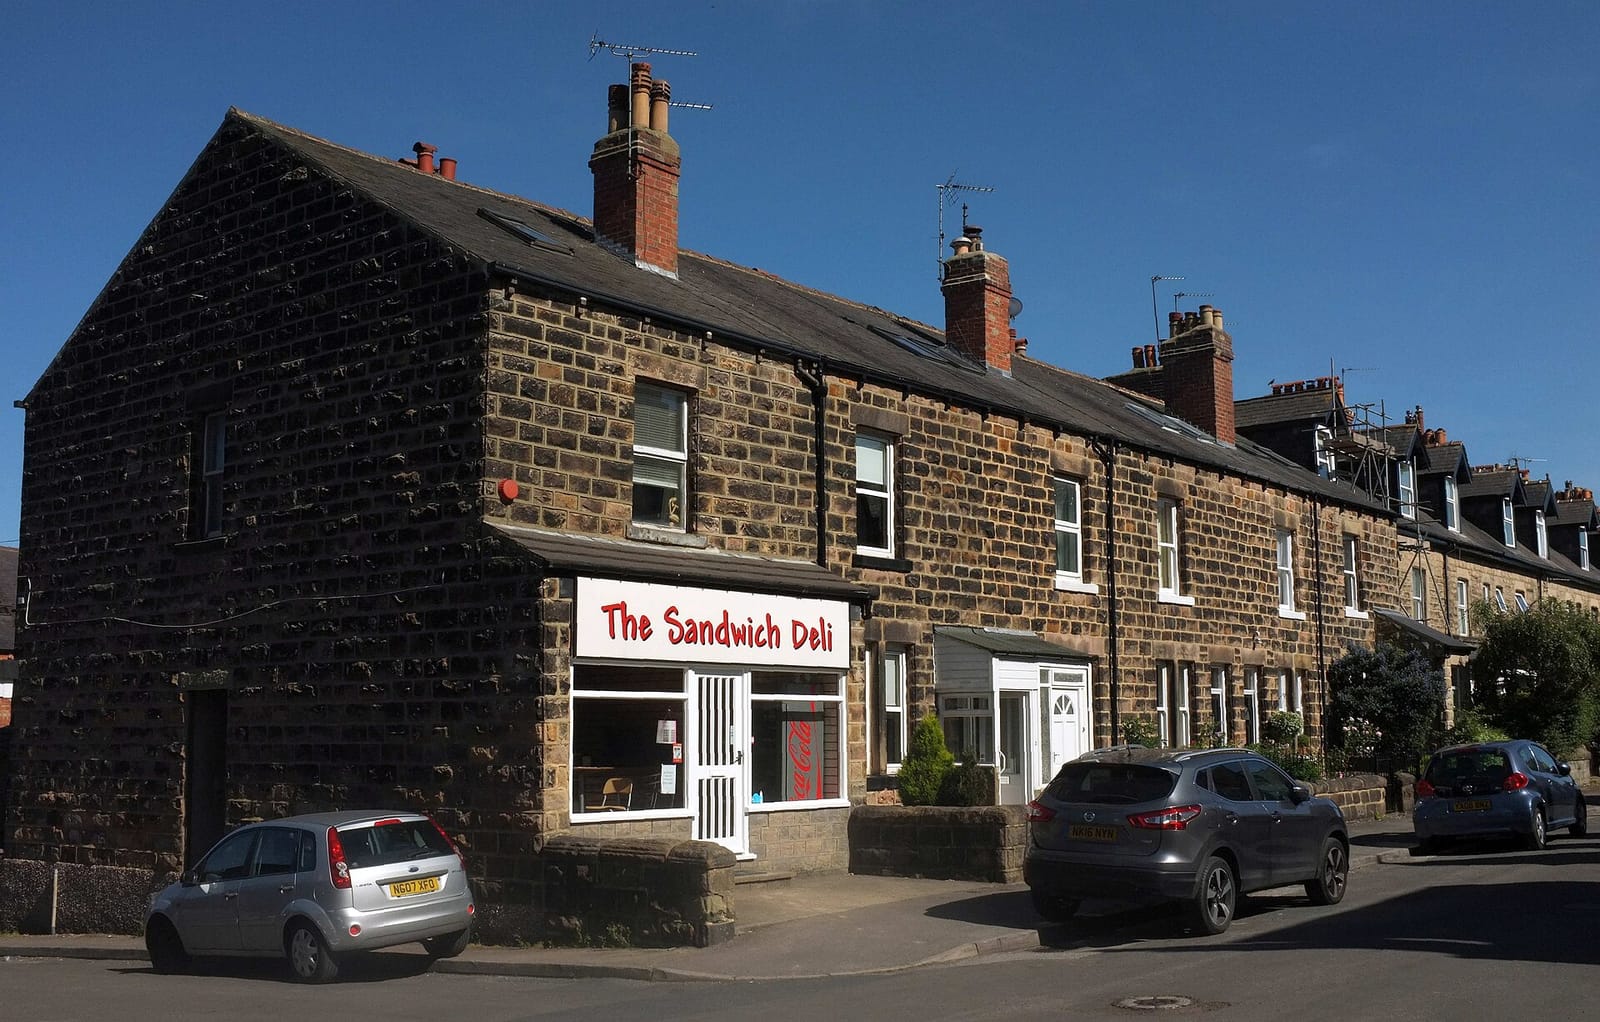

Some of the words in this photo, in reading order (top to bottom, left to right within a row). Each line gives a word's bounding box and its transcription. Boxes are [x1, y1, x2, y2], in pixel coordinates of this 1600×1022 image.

[600, 601, 653, 641] The
[663, 605, 781, 650] Sandwich
[791, 616, 833, 652] Deli
[393, 881, 416, 895] NG07
[418, 878, 435, 891] XFO
